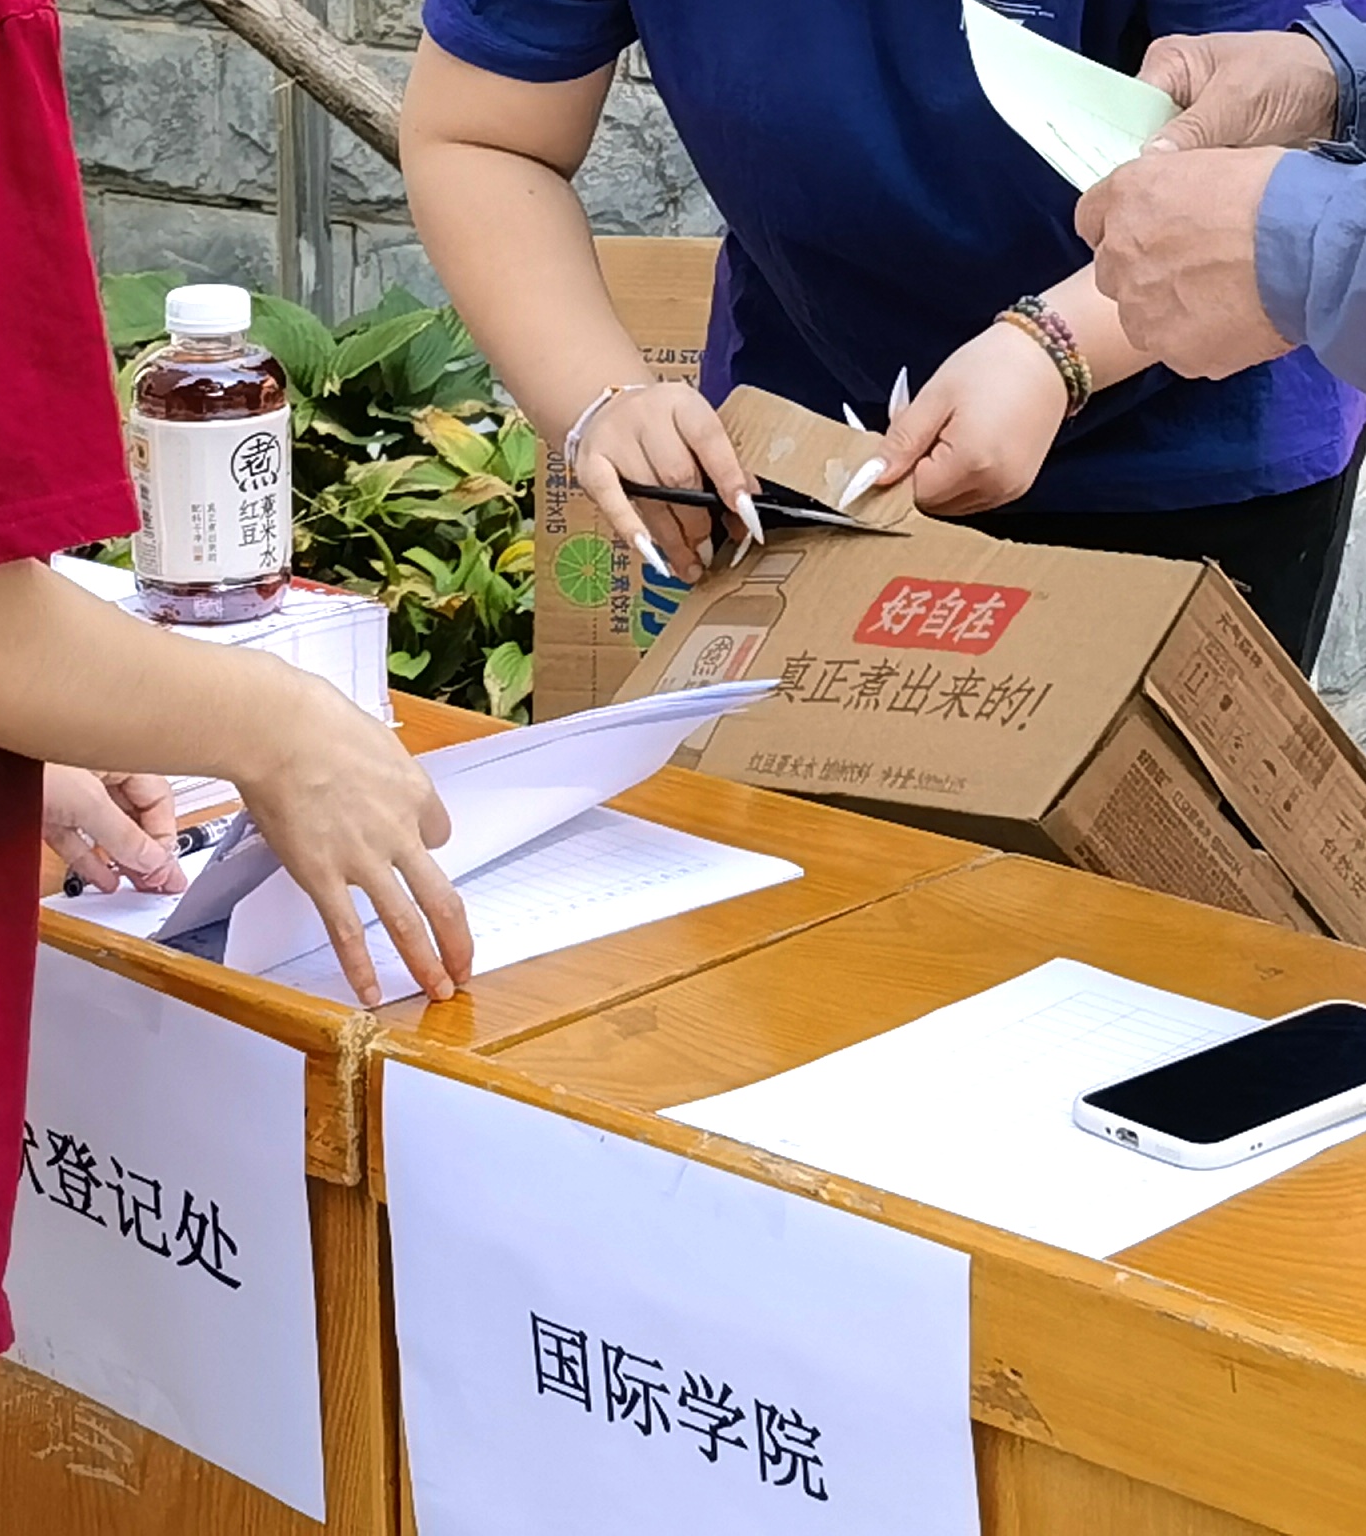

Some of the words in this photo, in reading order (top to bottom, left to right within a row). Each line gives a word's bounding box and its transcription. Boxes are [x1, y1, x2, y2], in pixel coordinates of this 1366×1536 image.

[231, 432, 282, 493] 煮
[867, 584, 1006, 645] 好自在
[530, 1309, 829, 1502] 国际学院
